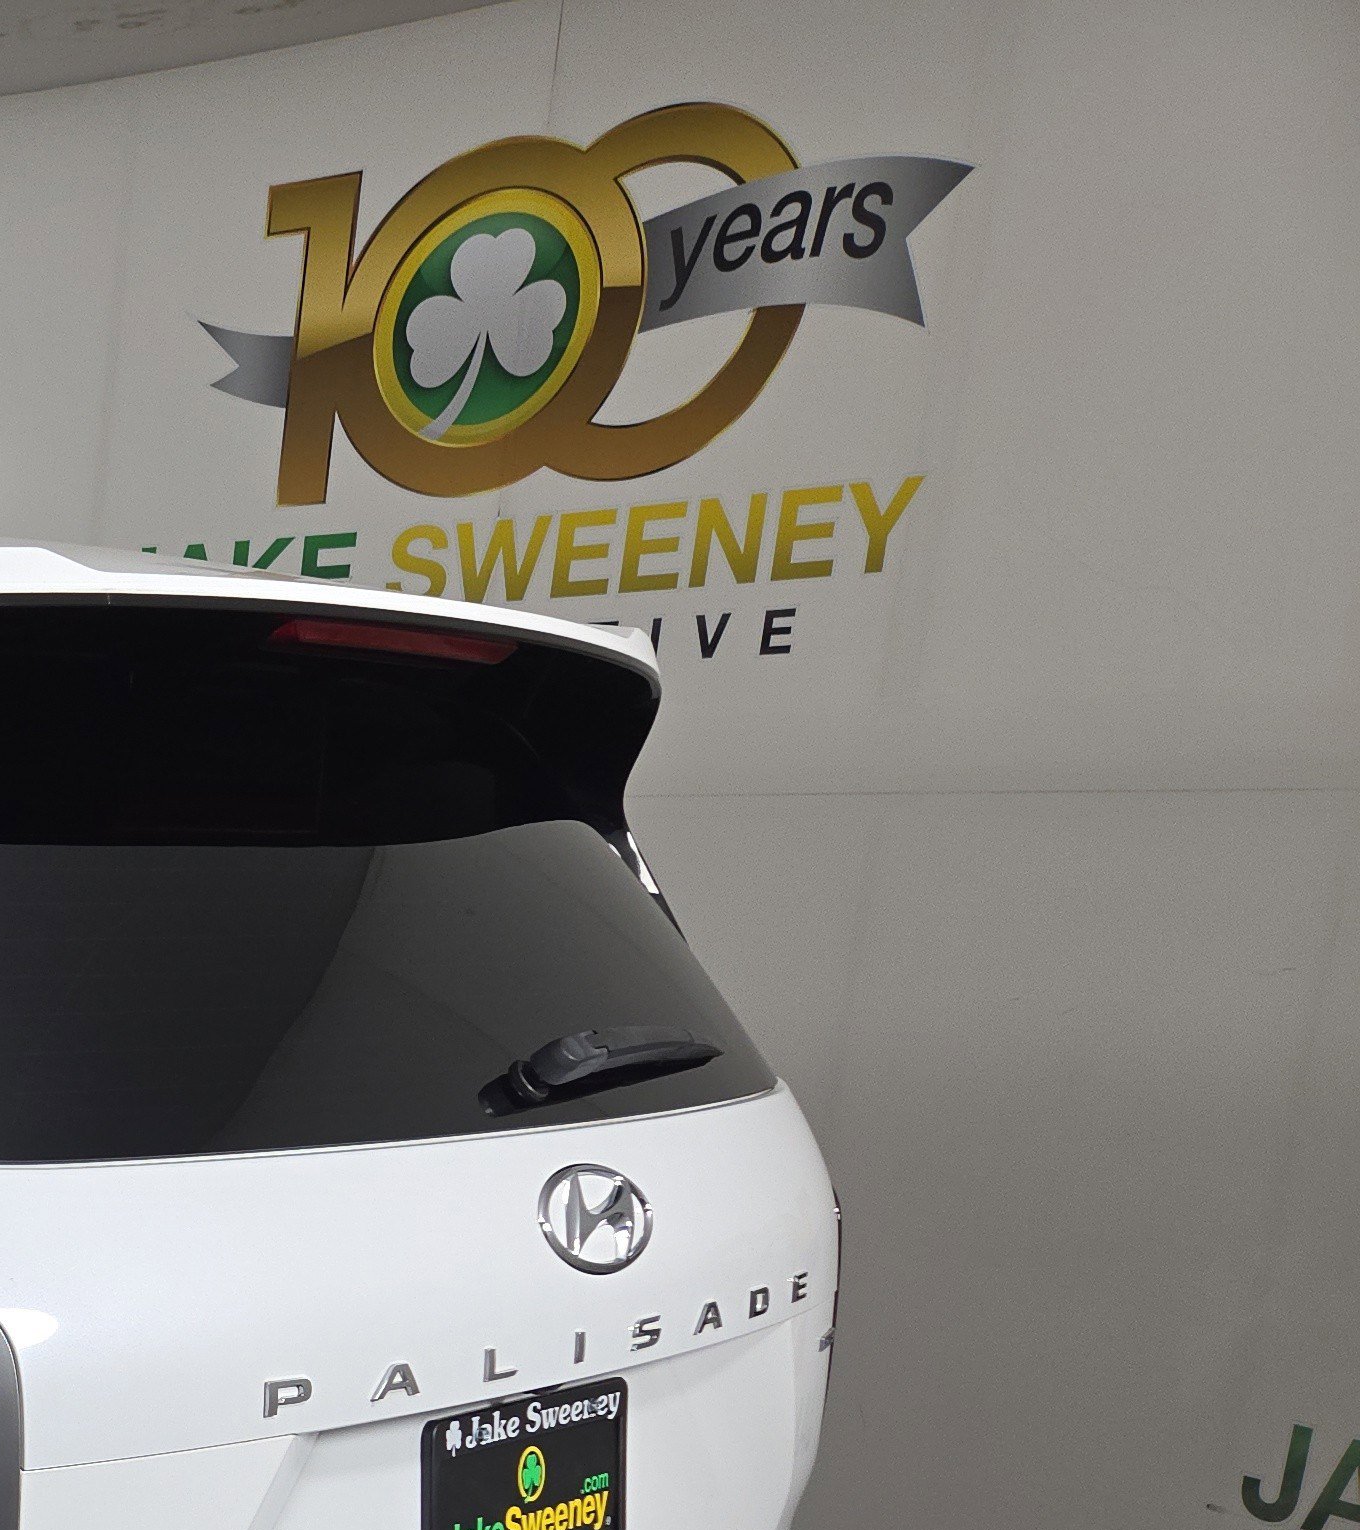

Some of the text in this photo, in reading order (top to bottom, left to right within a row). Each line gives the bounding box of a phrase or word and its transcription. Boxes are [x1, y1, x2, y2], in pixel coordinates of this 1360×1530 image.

[658, 180, 895, 312] years
[386, 474, 927, 604] SWEENEY
[588, 607, 797, 659] IVE
[261, 1270, 811, 1419] PALISADE
[465, 1410, 521, 1449] Jake
[580, 1472, 610, 1495] .com
